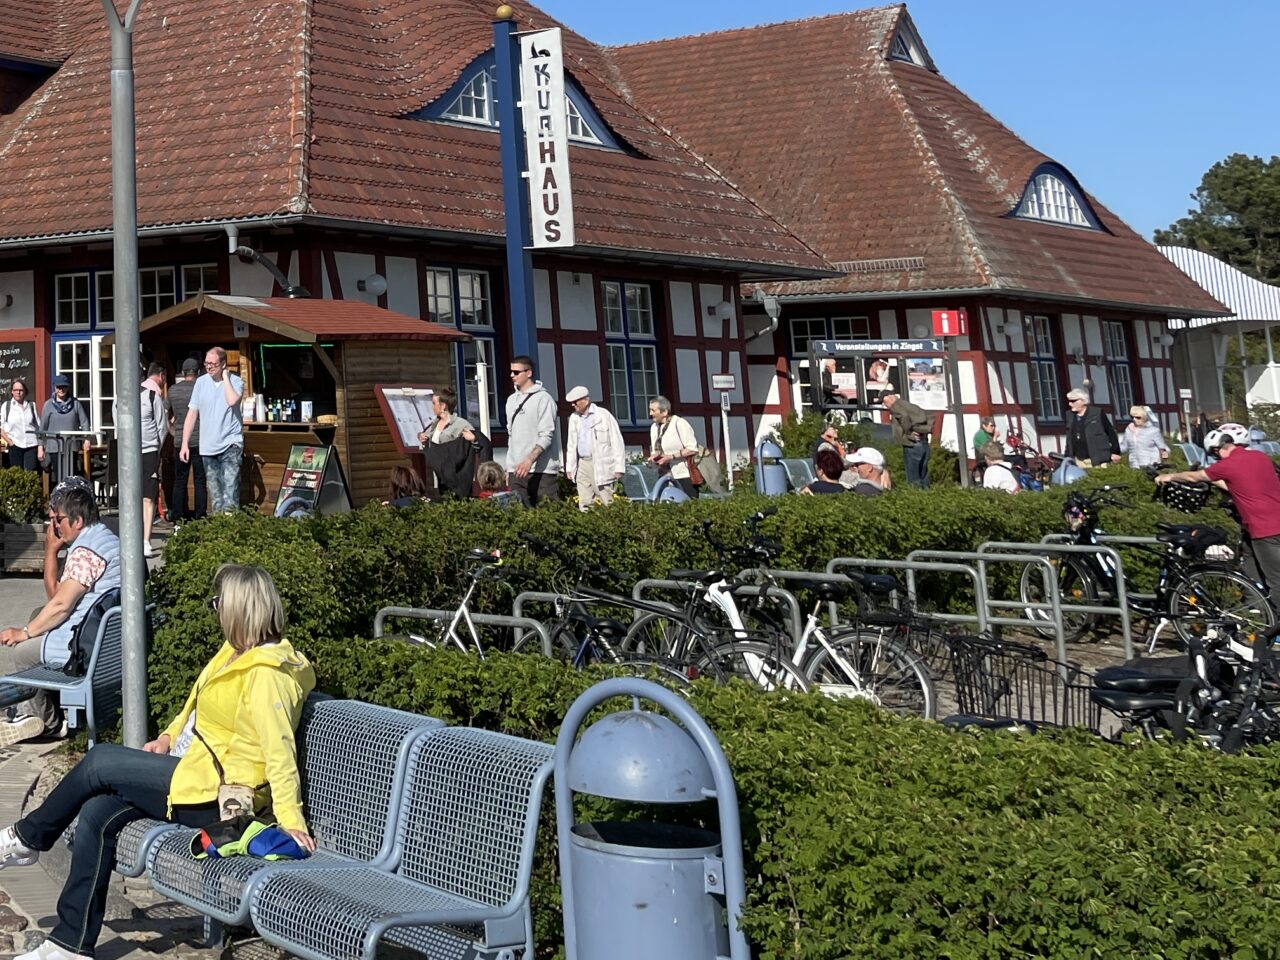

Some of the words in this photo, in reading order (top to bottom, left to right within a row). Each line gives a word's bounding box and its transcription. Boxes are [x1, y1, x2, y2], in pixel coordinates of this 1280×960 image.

[534, 63, 562, 243] KURHAUS
[835, 342, 891, 351] Veranstaltungen
[892, 342, 899, 350] in
[900, 342, 924, 351] Zingst
